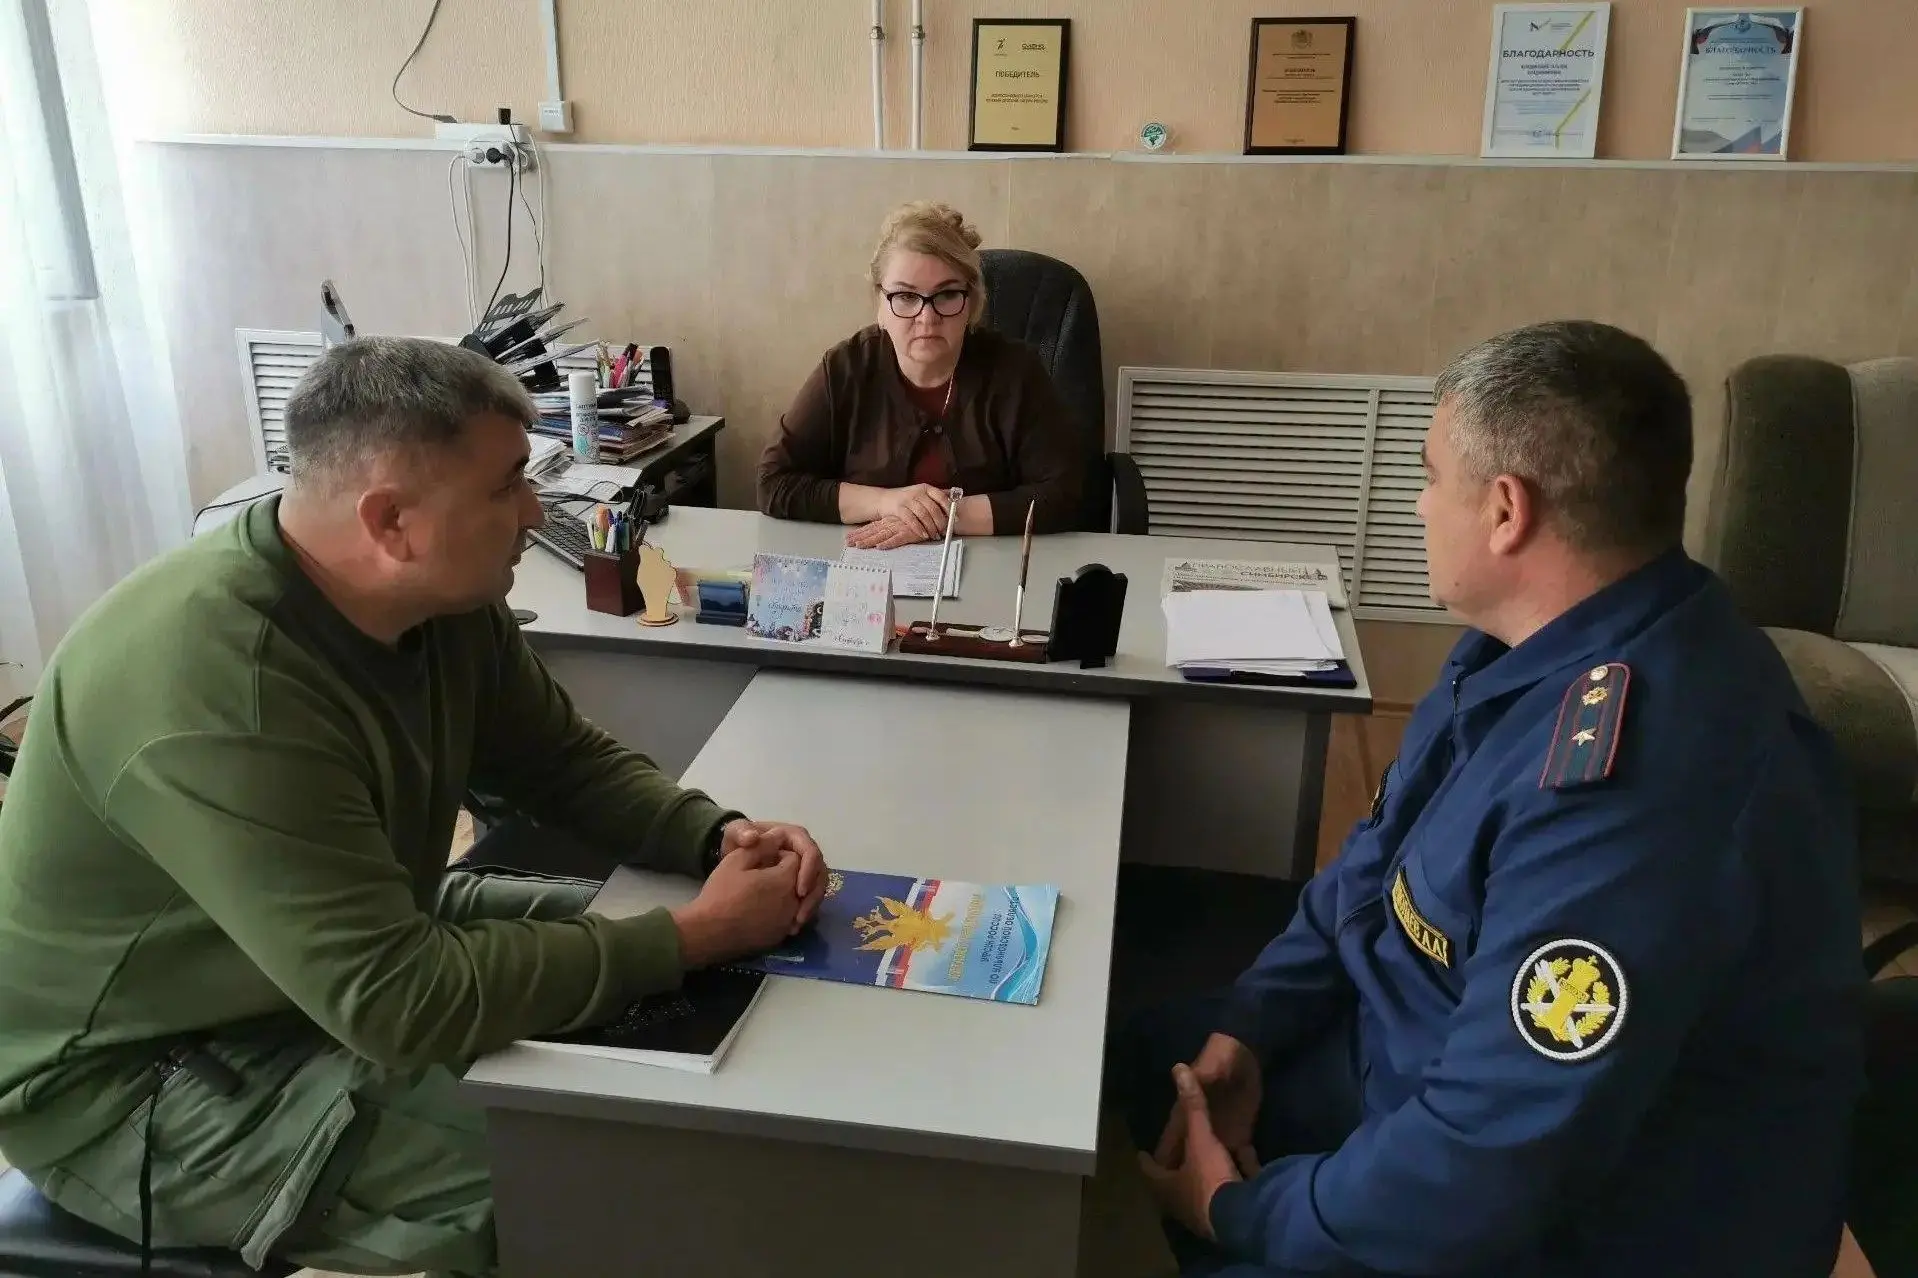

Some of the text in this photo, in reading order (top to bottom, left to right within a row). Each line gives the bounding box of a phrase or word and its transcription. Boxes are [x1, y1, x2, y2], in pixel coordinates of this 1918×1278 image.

[1502, 49, 1595, 58] БЛАГОДАРНОСТЬ
[995, 70, 1040, 79] ПОБЕДИТЕЛЬ
[981, 913, 1002, 962] УФСИН РОССИИ
[989, 973, 999, 984] ПО
